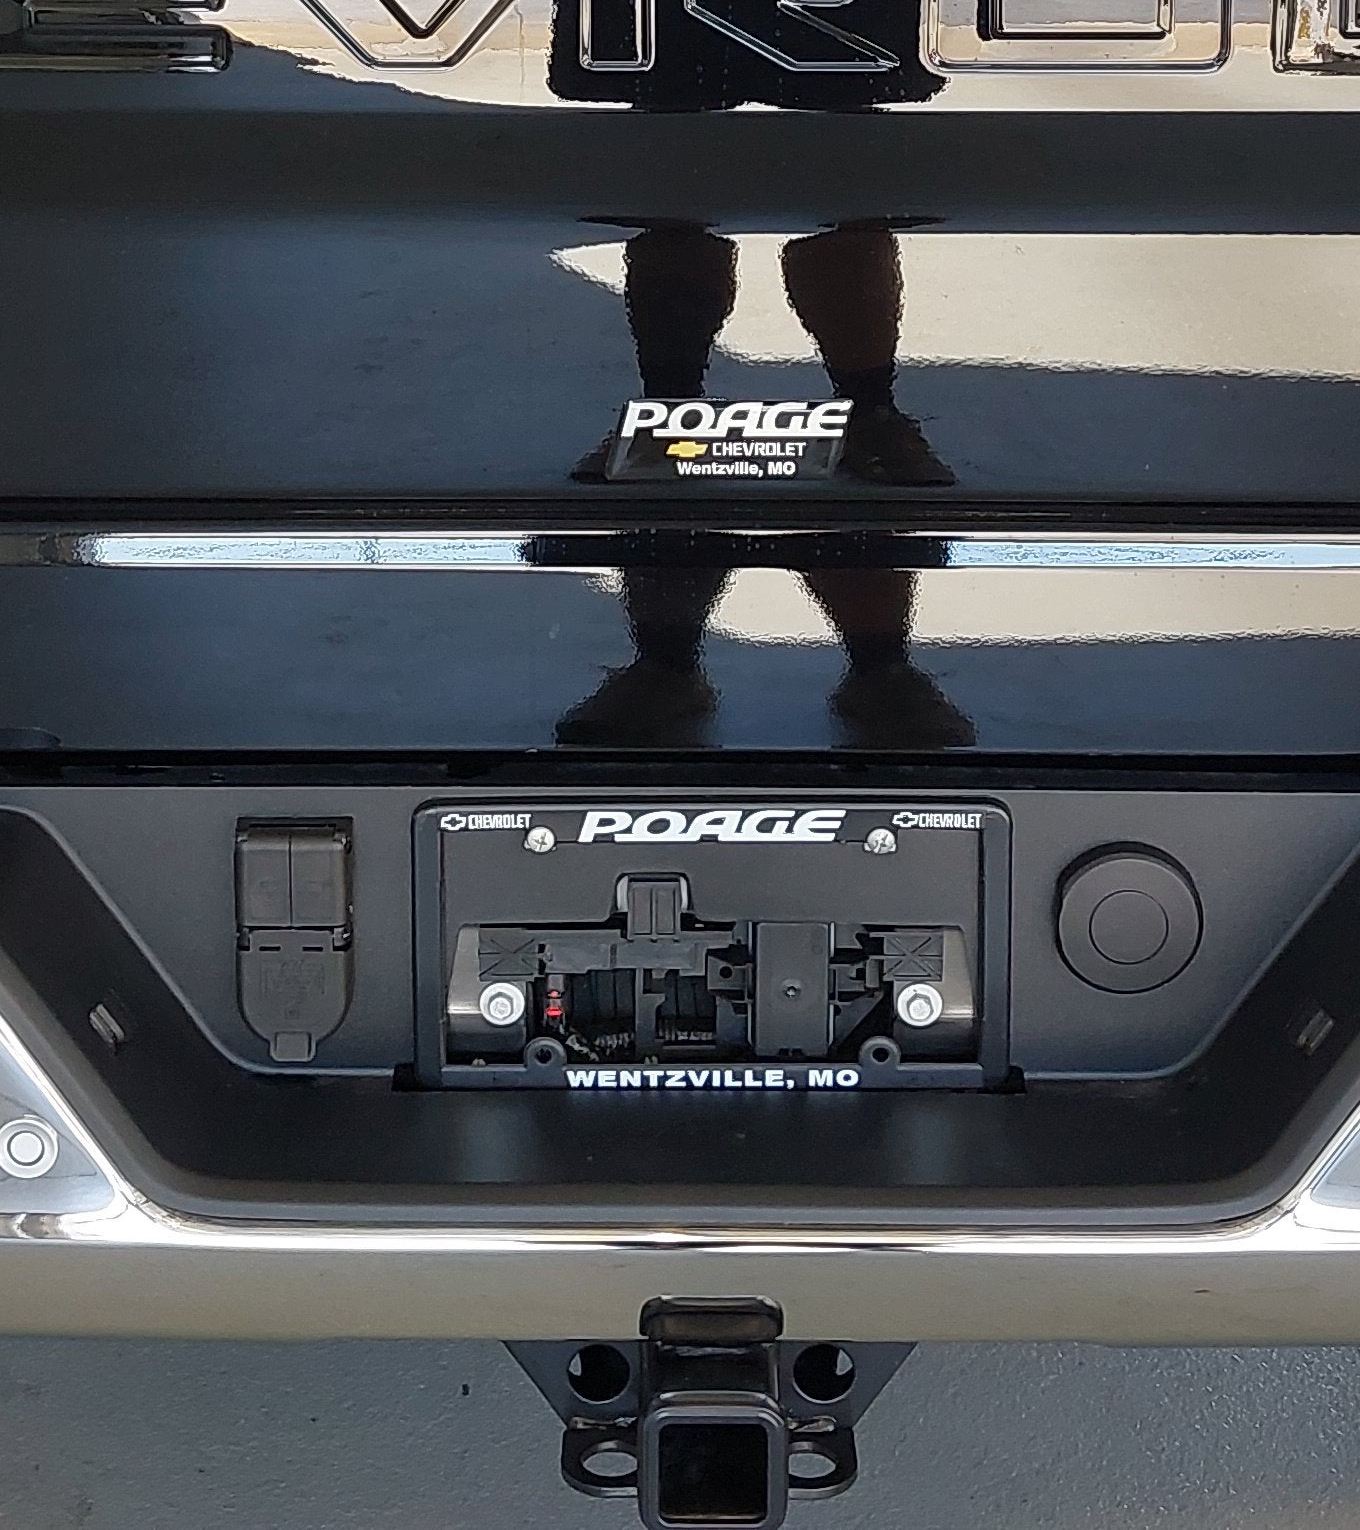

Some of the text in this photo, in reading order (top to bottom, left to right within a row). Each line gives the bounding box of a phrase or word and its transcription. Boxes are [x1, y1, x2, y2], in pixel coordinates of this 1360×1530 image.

[620, 399, 852, 437] POAGE
[712, 442, 806, 457] CHEVROLET
[677, 461, 796, 477] Wentzville, MO
[468, 814, 531, 829] CHEVROLET
[578, 810, 845, 843] POAGE
[918, 813, 982, 828] CHEVROLET
[566, 1070, 859, 1089] WENTZVILLE, MO
